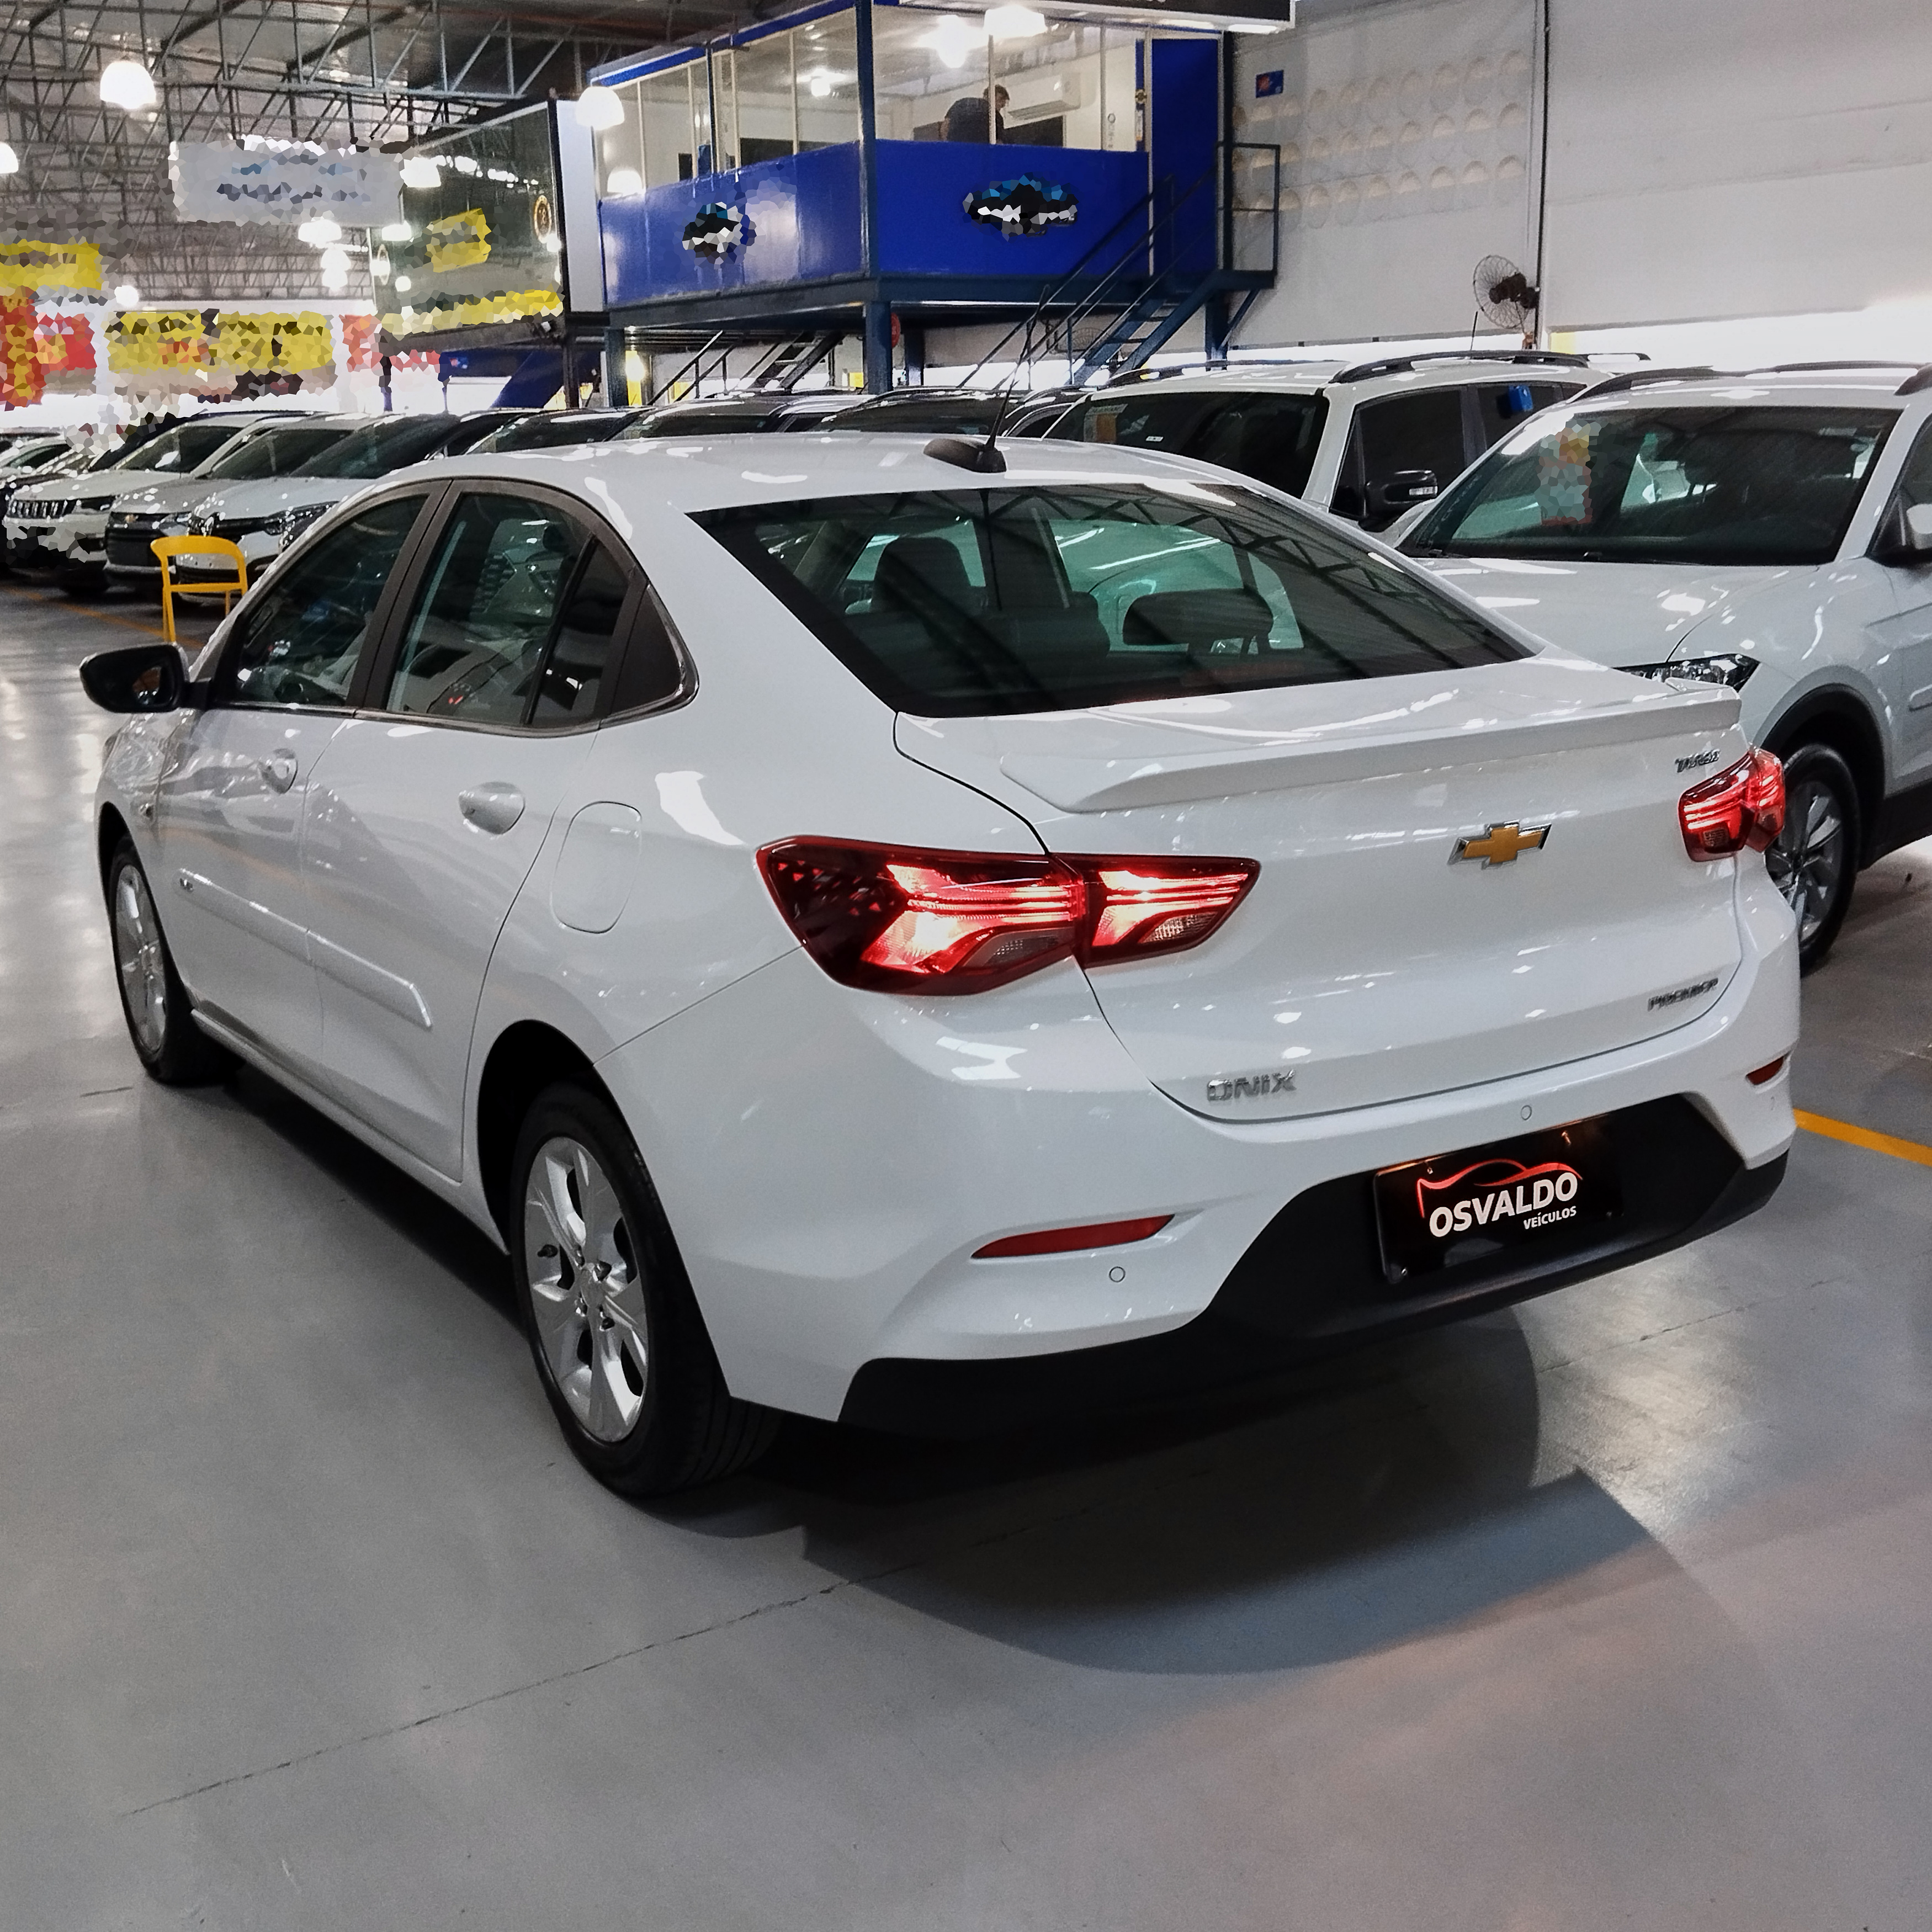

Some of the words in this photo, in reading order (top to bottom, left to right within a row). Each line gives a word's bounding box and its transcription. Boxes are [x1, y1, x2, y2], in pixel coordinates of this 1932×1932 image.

[1207, 1069, 1297, 1101] ONIX
[1429, 1172, 1578, 1238] OSVALDO
[1523, 1206, 1577, 1230] VEÍCULOS
